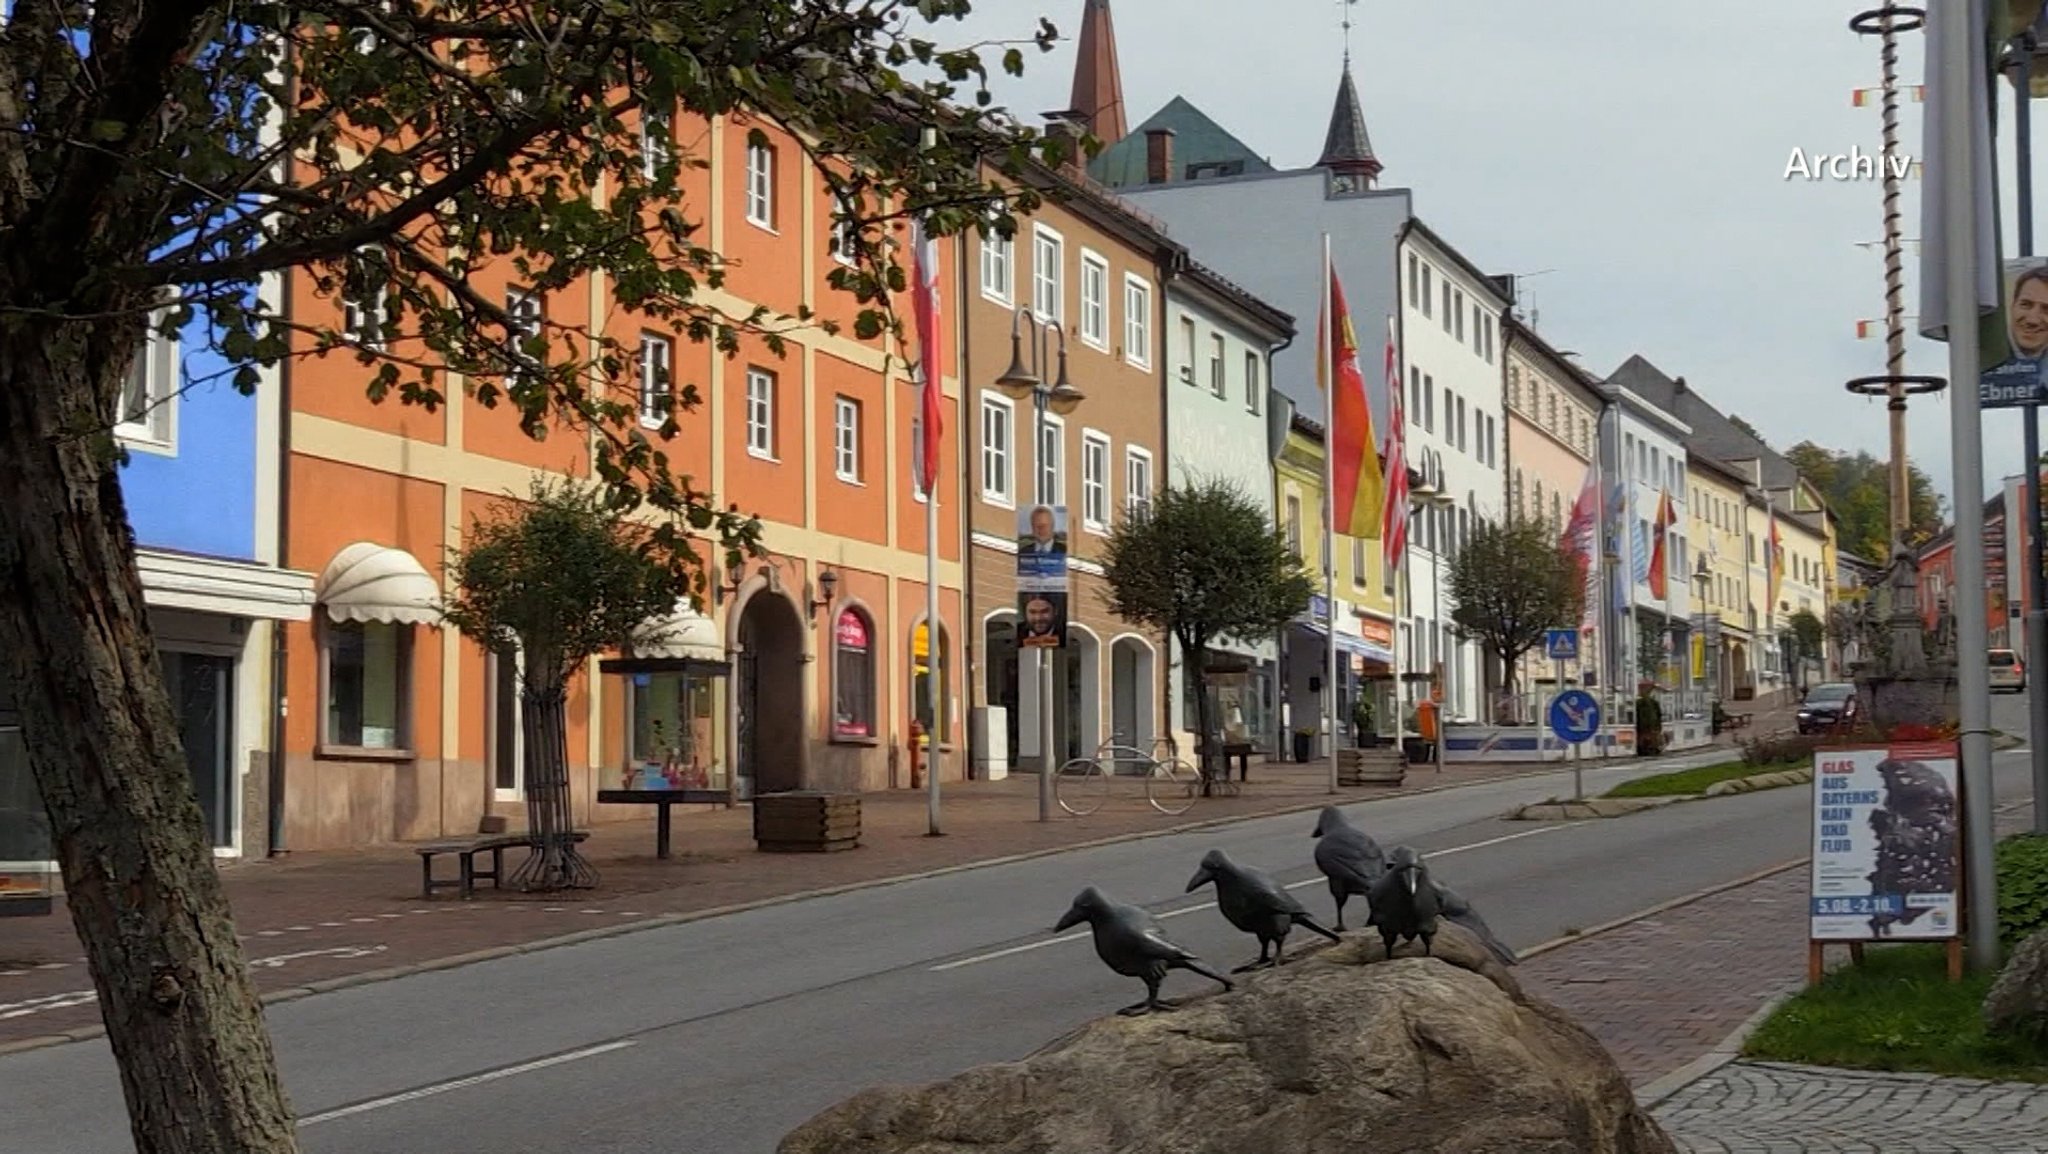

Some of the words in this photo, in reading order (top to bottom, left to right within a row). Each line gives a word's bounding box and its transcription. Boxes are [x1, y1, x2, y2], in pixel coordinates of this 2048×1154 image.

[1980, 383, 2038, 400] Ebner
[1822, 761, 1855, 774] GLAS
[1822, 777, 1848, 789] AUS
[1821, 791, 1879, 805] BAYERNS
